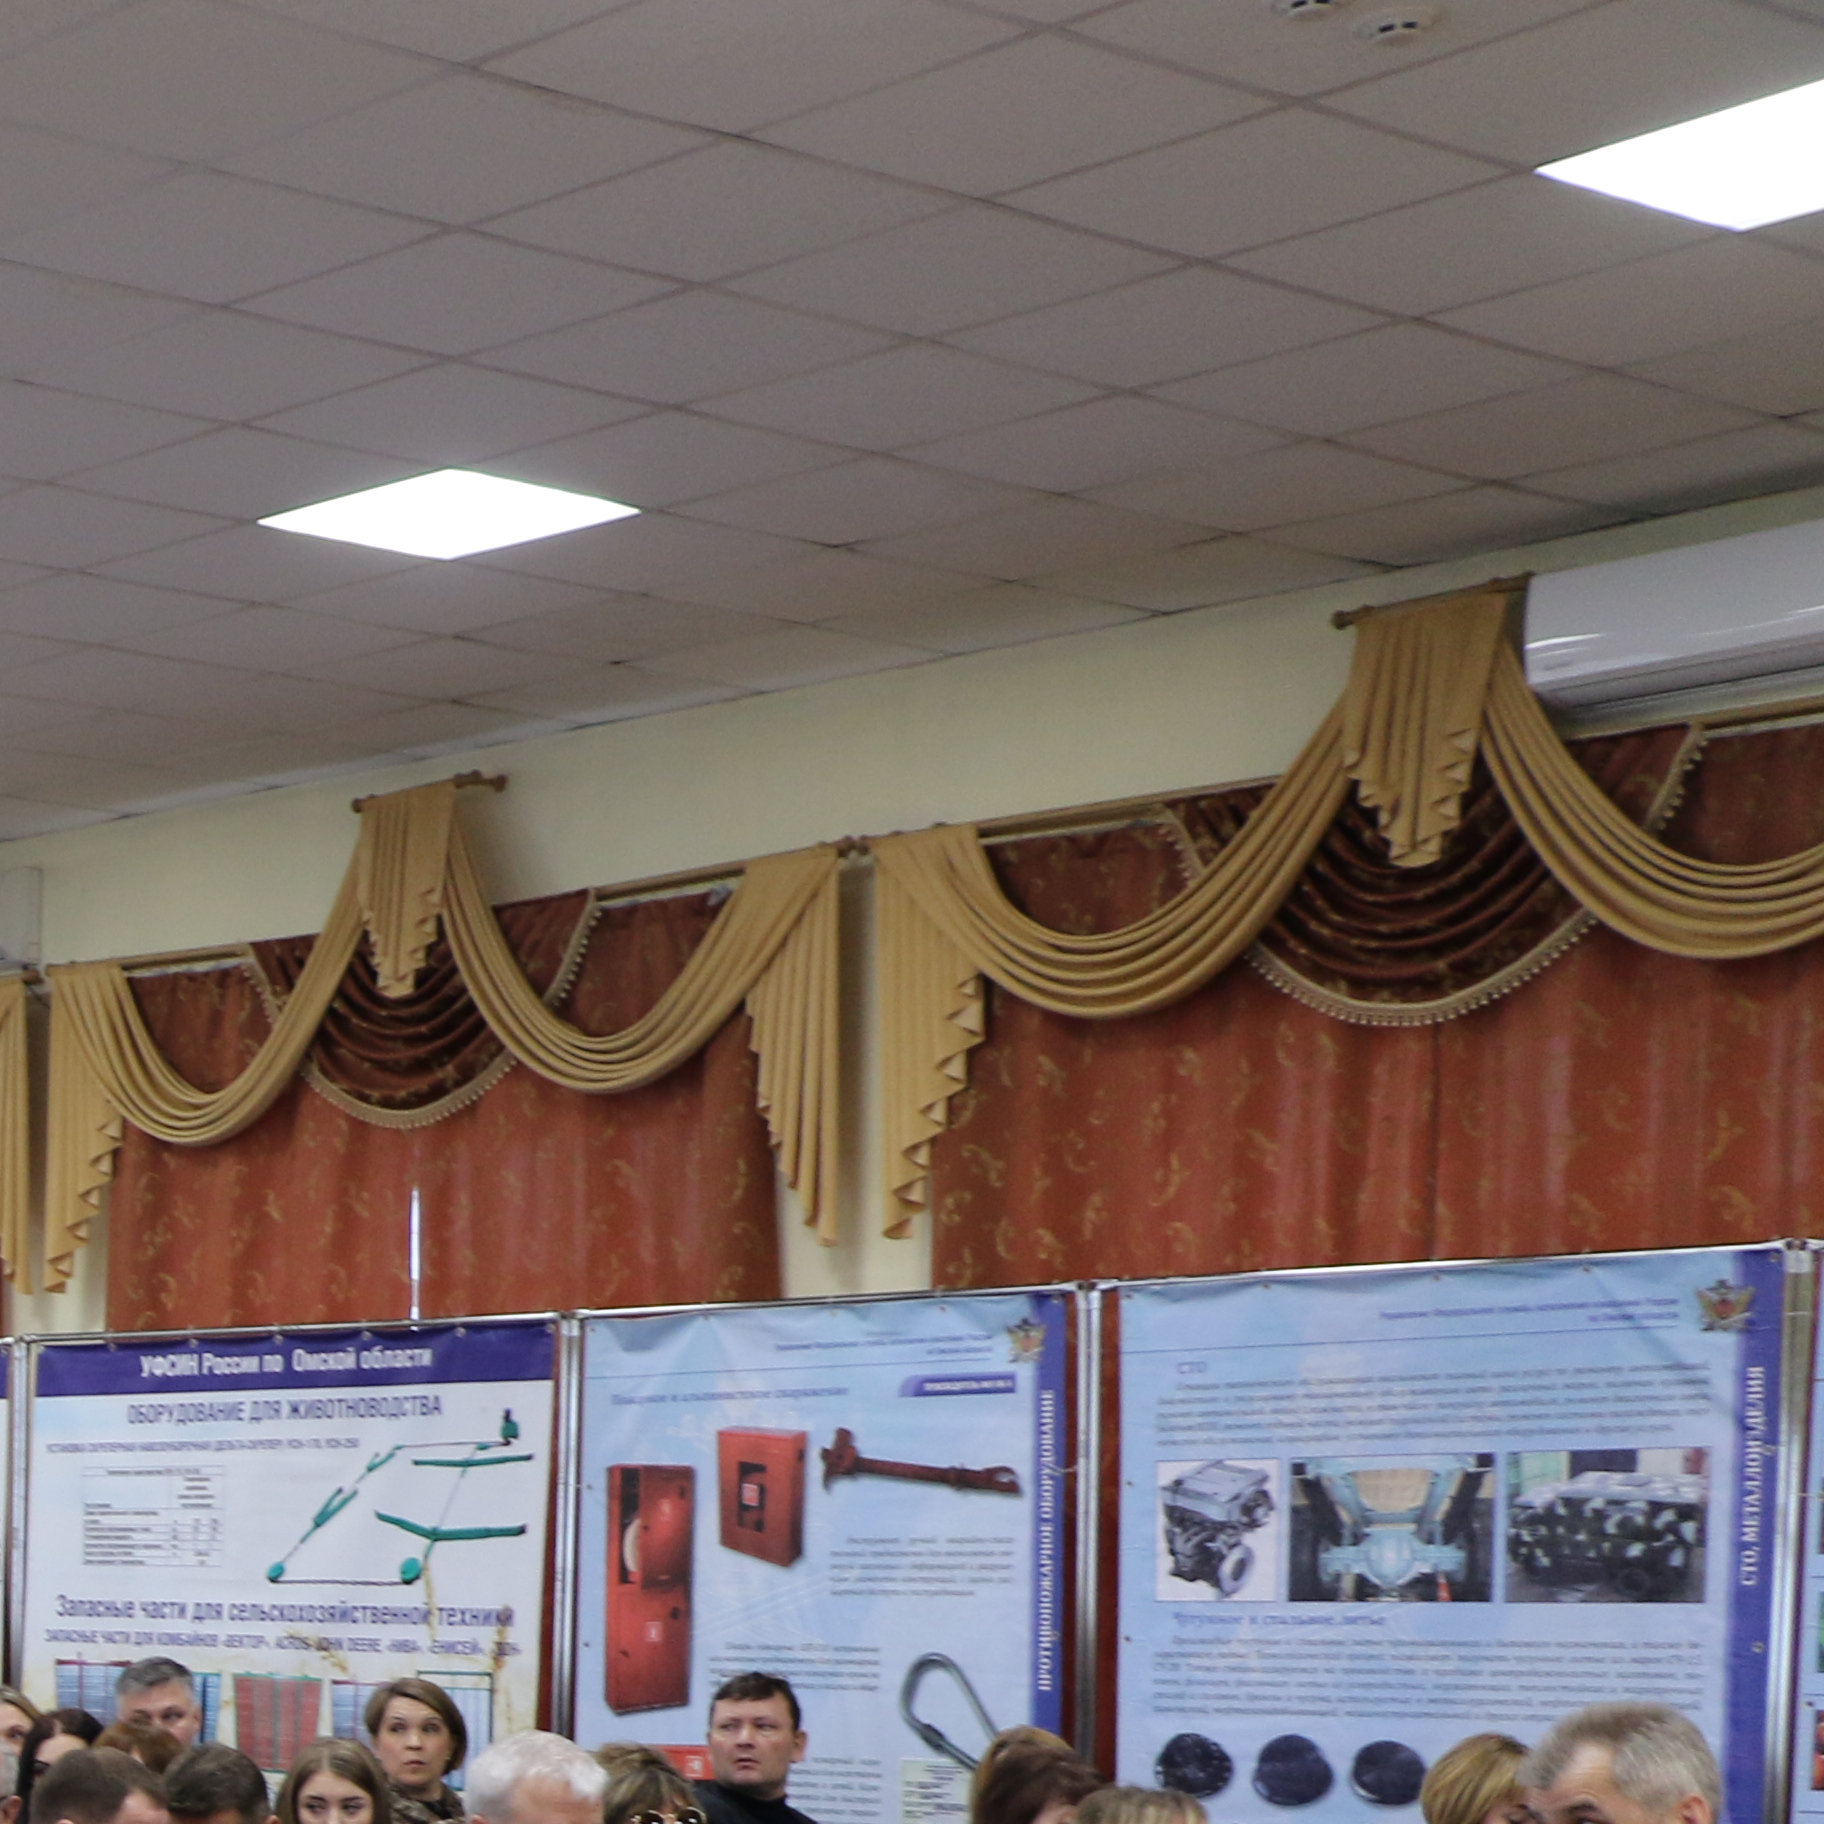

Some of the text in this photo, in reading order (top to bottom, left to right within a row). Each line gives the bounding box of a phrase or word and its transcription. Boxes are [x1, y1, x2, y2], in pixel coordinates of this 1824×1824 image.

[140, 1346, 433, 1378] УФСИН России по Омской области
[127, 1394, 443, 1426] ОБОРУДОВАНИЕ ДЛЯ ЖИВОТНОВОДСТВА
[1037, 1389, 1057, 1692] ПРОТИВОПОЖАРНОЕ ОБОРУДОВАНИЕ
